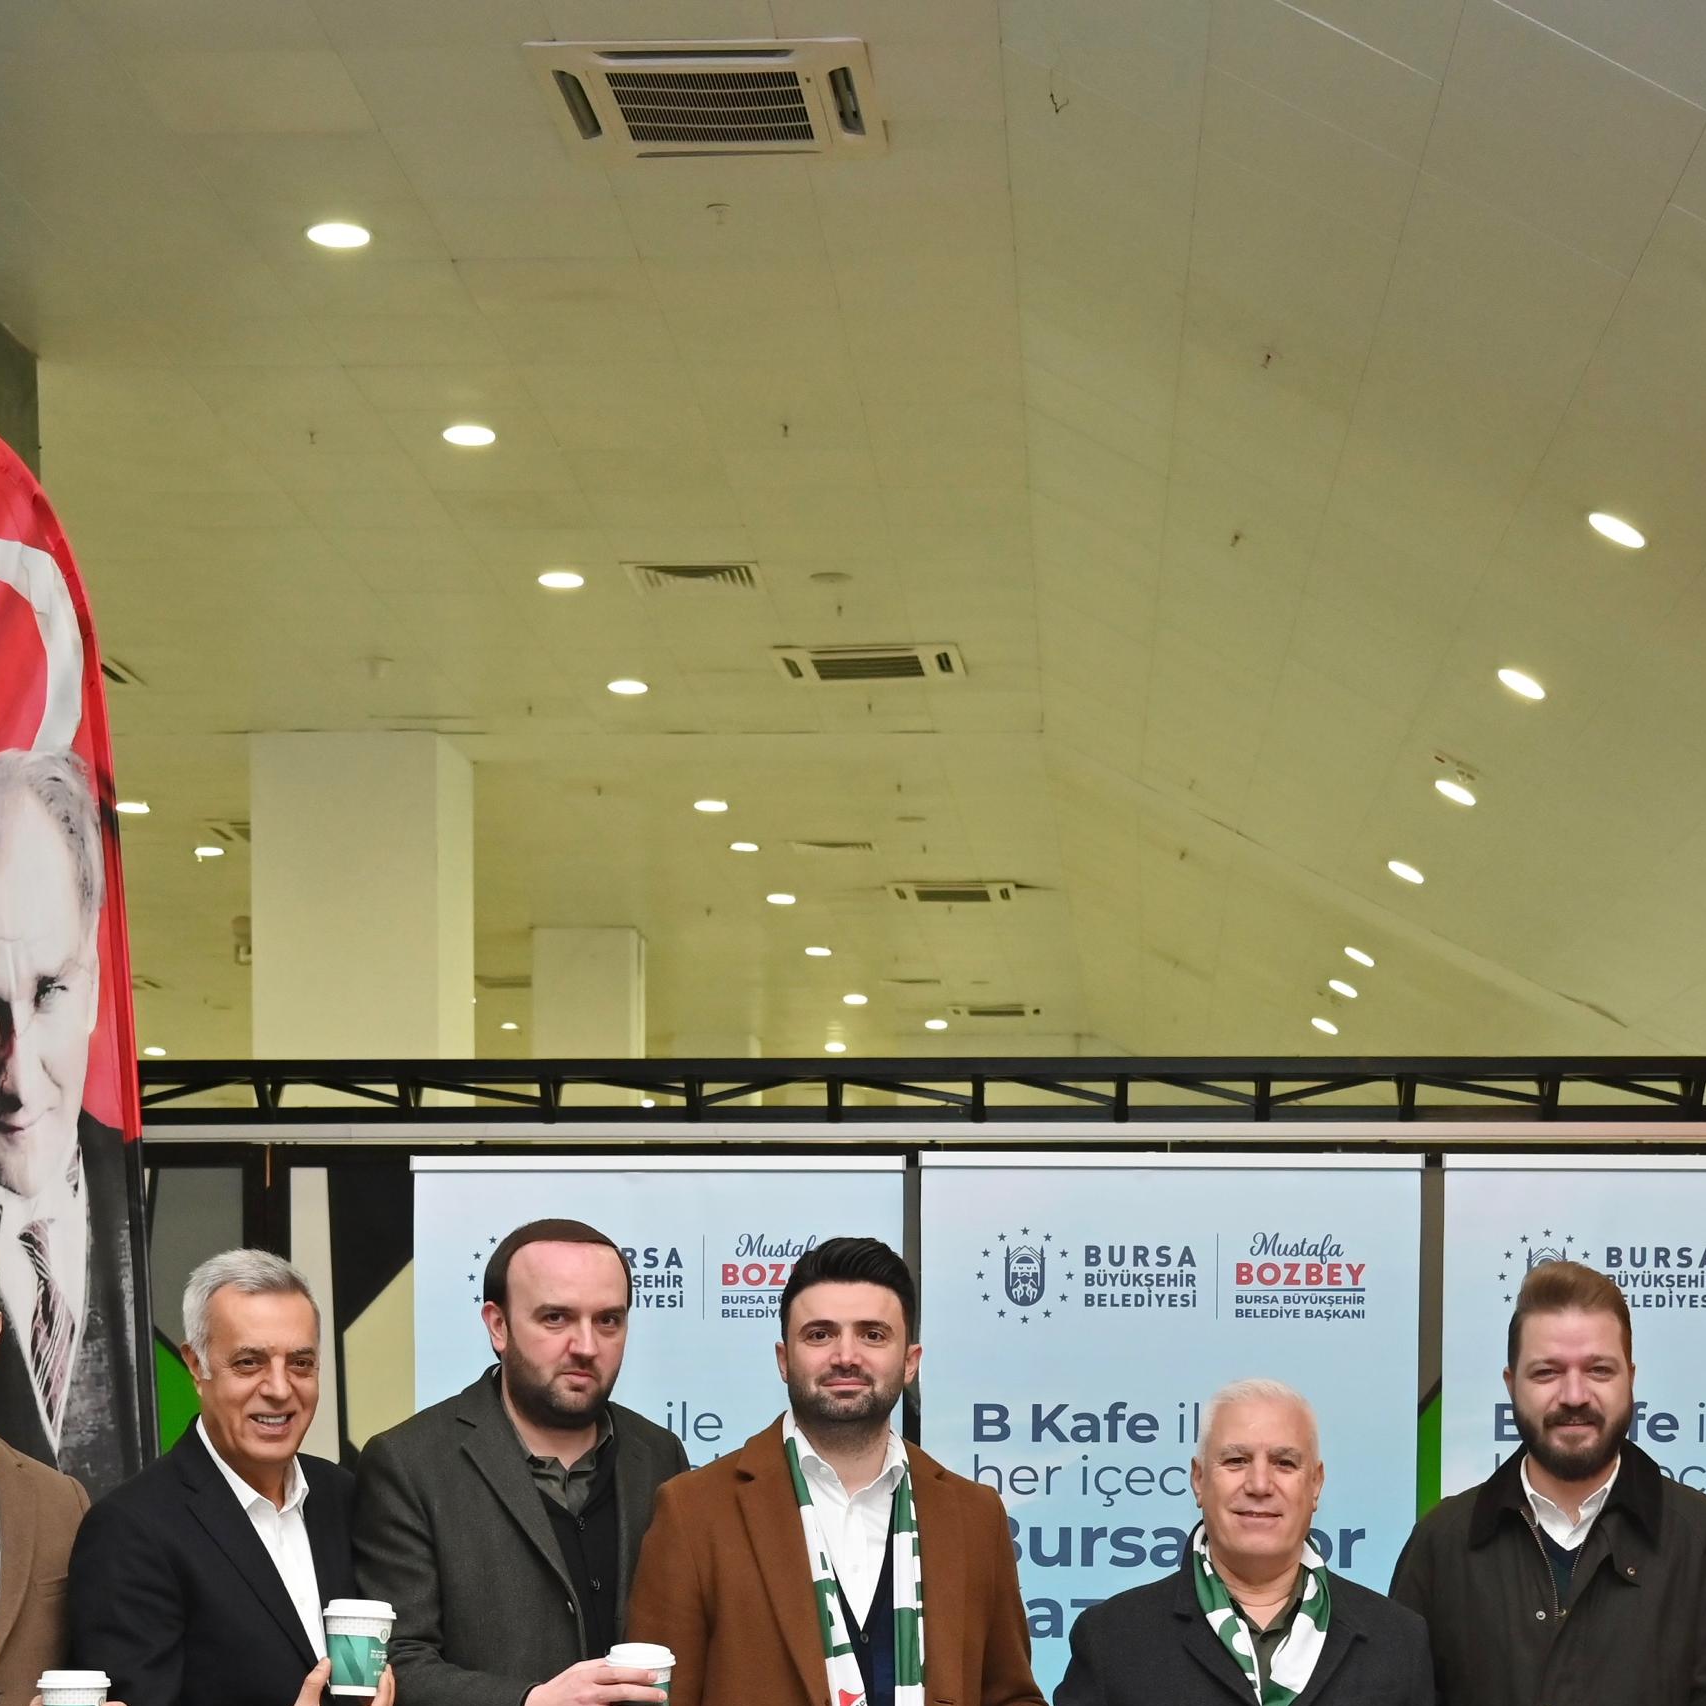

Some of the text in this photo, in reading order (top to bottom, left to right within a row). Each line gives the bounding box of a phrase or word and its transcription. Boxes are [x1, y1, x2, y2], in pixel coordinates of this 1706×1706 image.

[620, 1247, 684, 1269] RSA
[1084, 1245, 1197, 1268] BURSA
[1249, 1231, 1344, 1265] Mustafa
[631, 1270, 684, 1292] ŞEHİR
[721, 1263, 797, 1287] BOZ
[1084, 1269, 1197, 1289] BÜYÜKŞEHİR
[1235, 1262, 1366, 1287] BOZBEY
[635, 1289, 684, 1308] İYESİ
[721, 1294, 764, 1305] BURSA
[1084, 1289, 1197, 1308] BELEDİYESİ
[1235, 1292, 1365, 1307] BURSA BÜYÜKŞEHİR
[721, 1306, 782, 1319] BELEDİY
[1235, 1306, 1366, 1322] BELEDİYE BAŞKANI
[666, 1400, 724, 1442] ile
[972, 1401, 1200, 1444] B Kafe il
[1628, 1400, 1680, 1443] fe
[973, 1453, 1189, 1508] her içec
